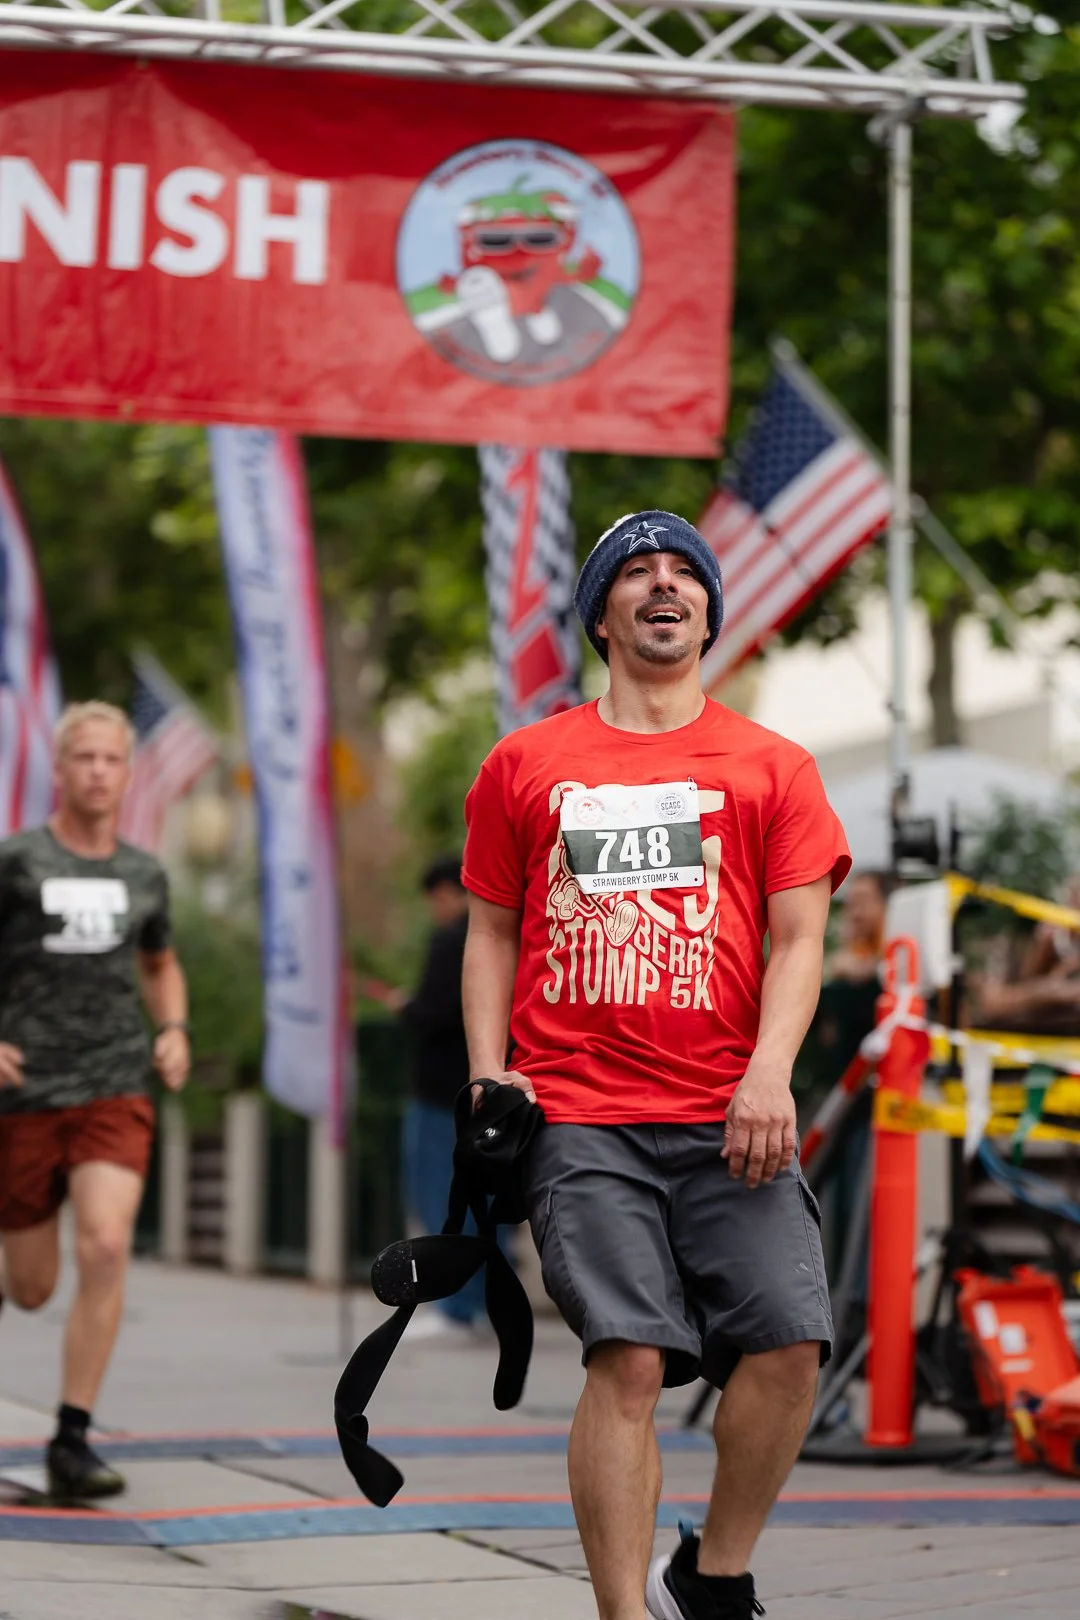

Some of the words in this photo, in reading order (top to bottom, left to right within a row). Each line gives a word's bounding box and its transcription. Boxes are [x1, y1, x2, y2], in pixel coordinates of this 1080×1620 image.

[0, 156, 330, 285] NISH
[592, 876, 641, 888] STRAWBERRY
[642, 873, 668, 884] STOMP
[669, 872, 679, 882] 5K
[595, 826, 672, 872] 748
[543, 916, 661, 1006] STOMP
[669, 956, 716, 1011] 5K
